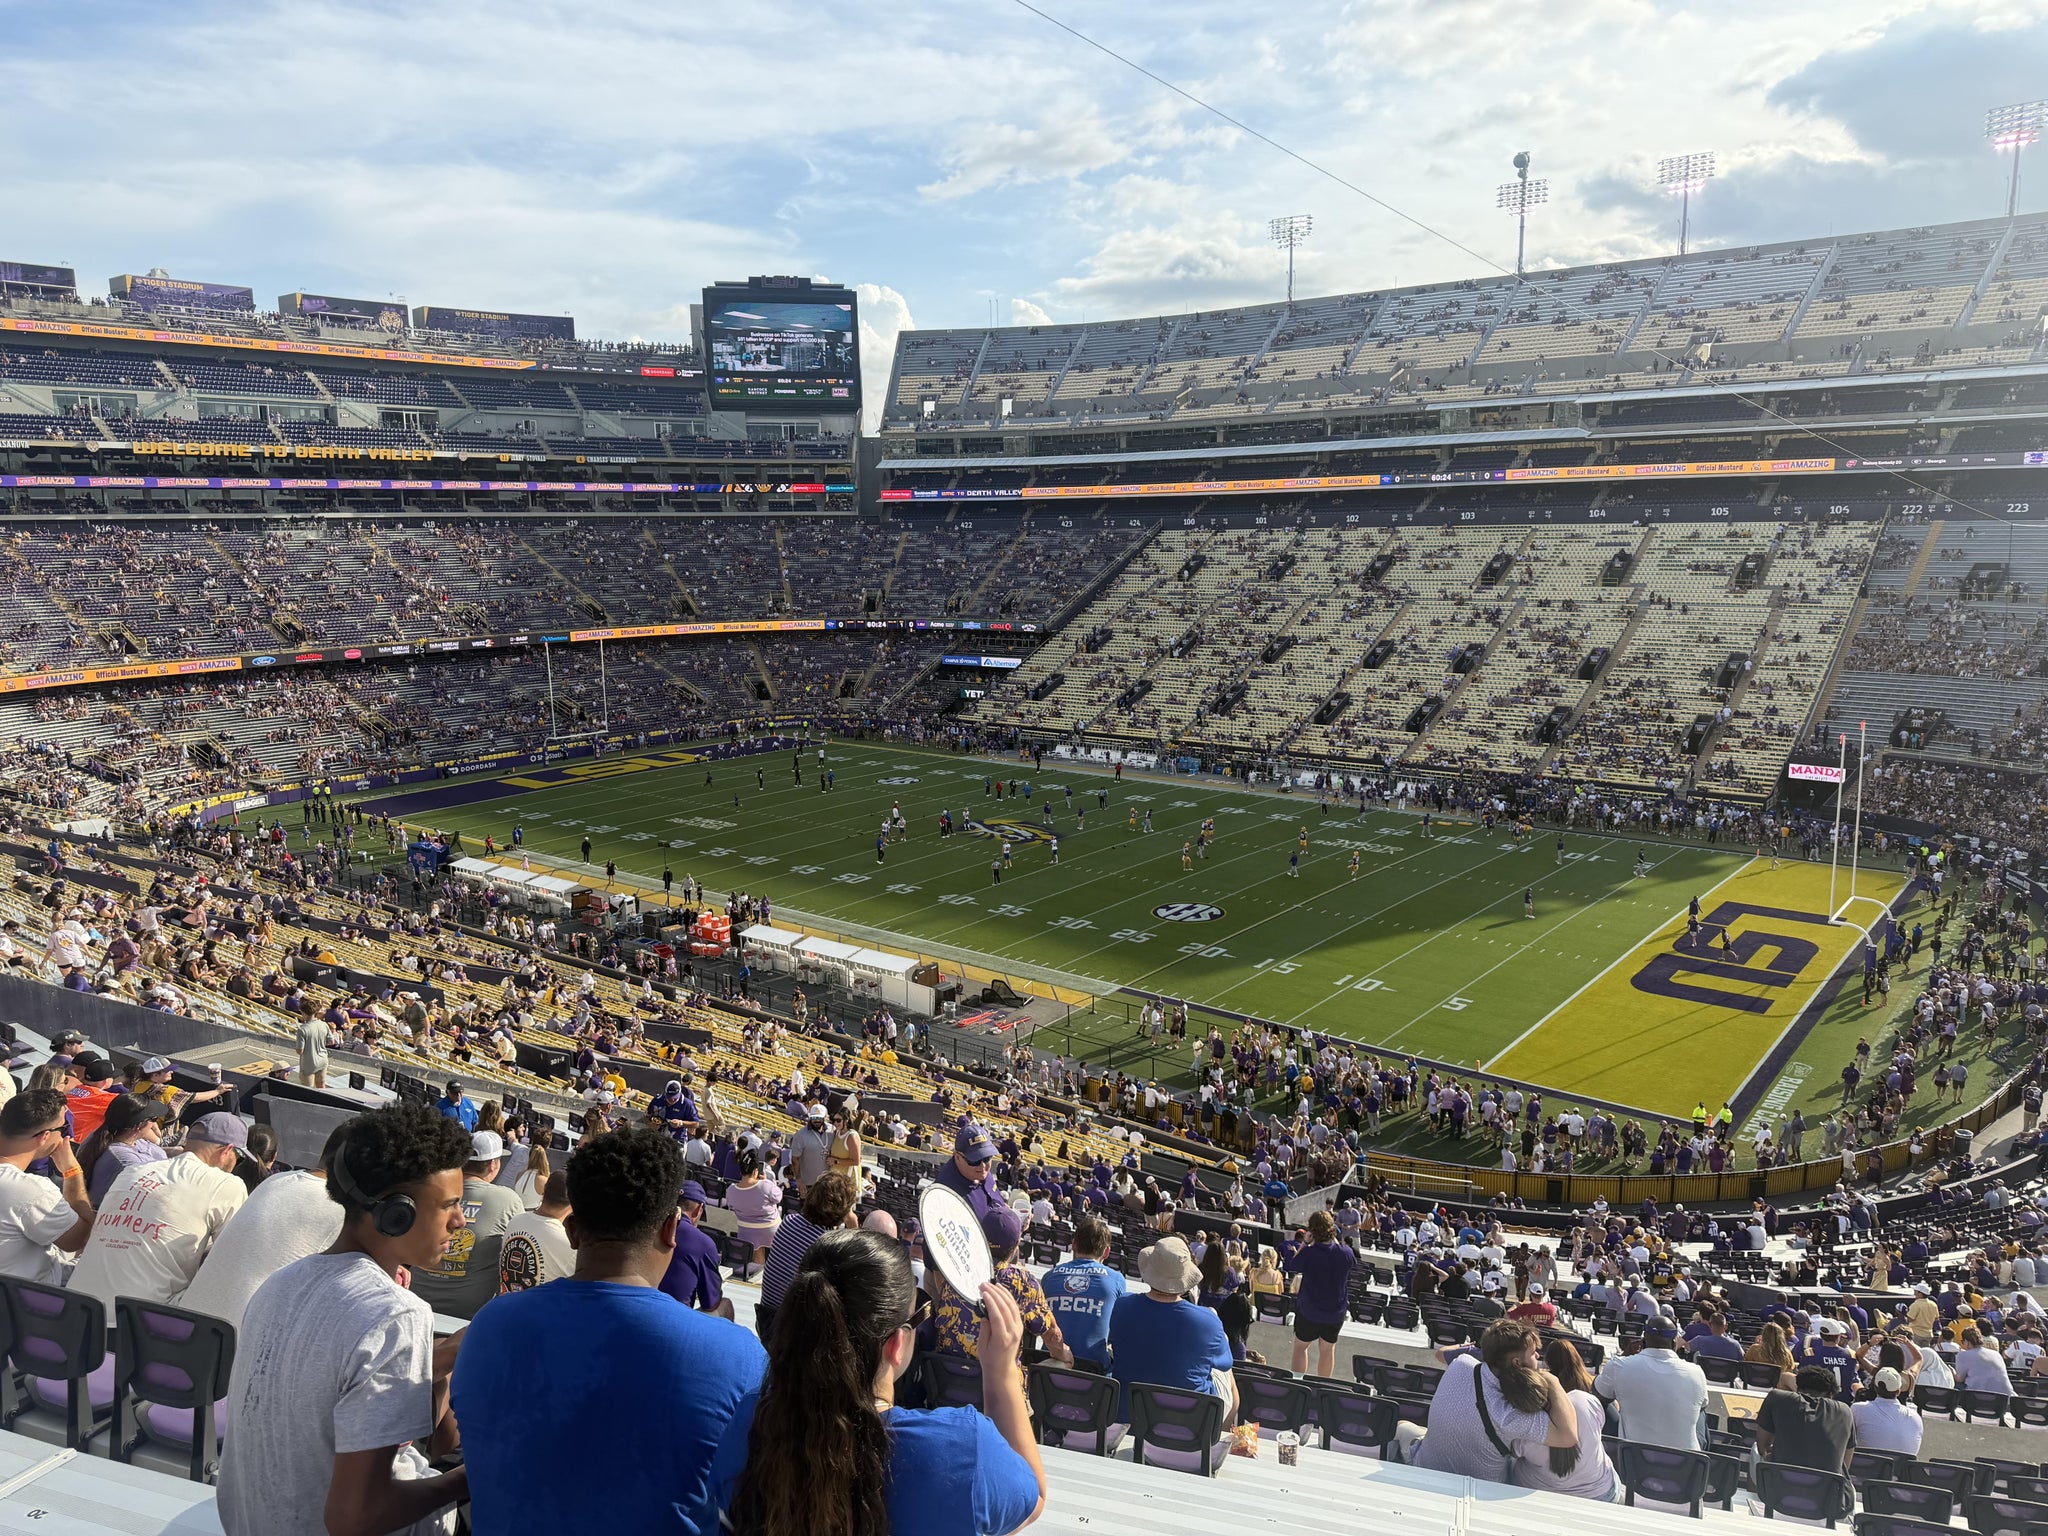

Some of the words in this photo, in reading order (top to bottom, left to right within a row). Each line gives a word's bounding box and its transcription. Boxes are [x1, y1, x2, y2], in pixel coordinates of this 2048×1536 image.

[142, 278, 167, 288] TIGER
[168, 281, 204, 291] STADIUM
[461, 311, 480, 319] TIGER
[480, 312, 509, 321] STADIUM
[34, 322, 72, 332] AMAZING
[81, 326, 103, 335] Official
[104, 327, 128, 336] Mustard
[170, 333, 204, 343] AMAZING
[212, 336, 231, 344] Official
[232, 337, 254, 346] Mustard
[291, 343, 321, 352] AMAZING
[398, 352, 425, 360] AMAZING
[132, 441, 252, 457] WELCOME
[262, 445, 288, 458] TO
[295, 445, 360, 460] DEATH
[367, 448, 434, 461] VALLEY
[1651, 464, 1687, 473] AMAZING
[1696, 464, 1717, 472] Official
[1718, 463, 1744, 471] Mustard
[1790, 460, 1829, 469] AMAZING
[1431, 474, 1452, 482] 60:24
[1526, 469, 1558, 477] AMAZING
[36, 476, 76, 485] AMAZING
[109, 477, 146, 486] AMAZING
[175, 478, 210, 486] AMAZING
[238, 479, 271, 487] AMAZING
[297, 479, 328, 487] AMAZING
[1710, 507, 1729, 516] 105
[1829, 505, 1850, 515] 106
[1902, 504, 1923, 514] 222
[2006, 503, 2030, 513] 223
[1346, 514, 1359, 523] 102
[1461, 511, 1476, 520] 103
[1588, 509, 1606, 518] 104
[422, 520, 436, 529] 418
[960, 521, 973, 529] 422
[1061, 520, 1073, 528] 423
[1129, 519, 1141, 527] 424
[1255, 516, 1267, 525] 101
[793, 621, 821, 629] AMAZING
[588, 630, 614, 638] AMAZING
[198, 659, 237, 671] AMAZING
[44, 672, 85, 684] AMAZING
[96, 669, 119, 679] Official
[120, 667, 149, 677] Mustard
[460, 761, 497, 773] DOORDASH
[1790, 766, 1842, 778] MANDA
[235, 797, 268, 810] BADGER
[831, 873, 873, 884] 50
[886, 883, 923, 895] 45
[938, 894, 977, 906] 40
[987, 904, 1033, 917] 35
[1047, 916, 1093, 929] 30
[1109, 928, 1158, 943] 25
[1176, 942, 1228, 958] 20
[1252, 958, 1304, 975] 15
[1333, 974, 1386, 992] 10
[1441, 996, 1475, 1012] 5
[1761, 1075, 1804, 1111] RAISING
[119, 1190, 149, 1211] all
[97, 1213, 168, 1240] runners
[1241, 1227, 1253, 1235] 211
[947, 1220, 971, 1259] Delta
[938, 1217, 972, 1273] Utilities
[518, 1239, 536, 1275] GAMEDAY
[1052, 1266, 1109, 1276] LOUISIANA
[1046, 1296, 1104, 1317] TECH
[1823, 1356, 1848, 1366] CHASE
